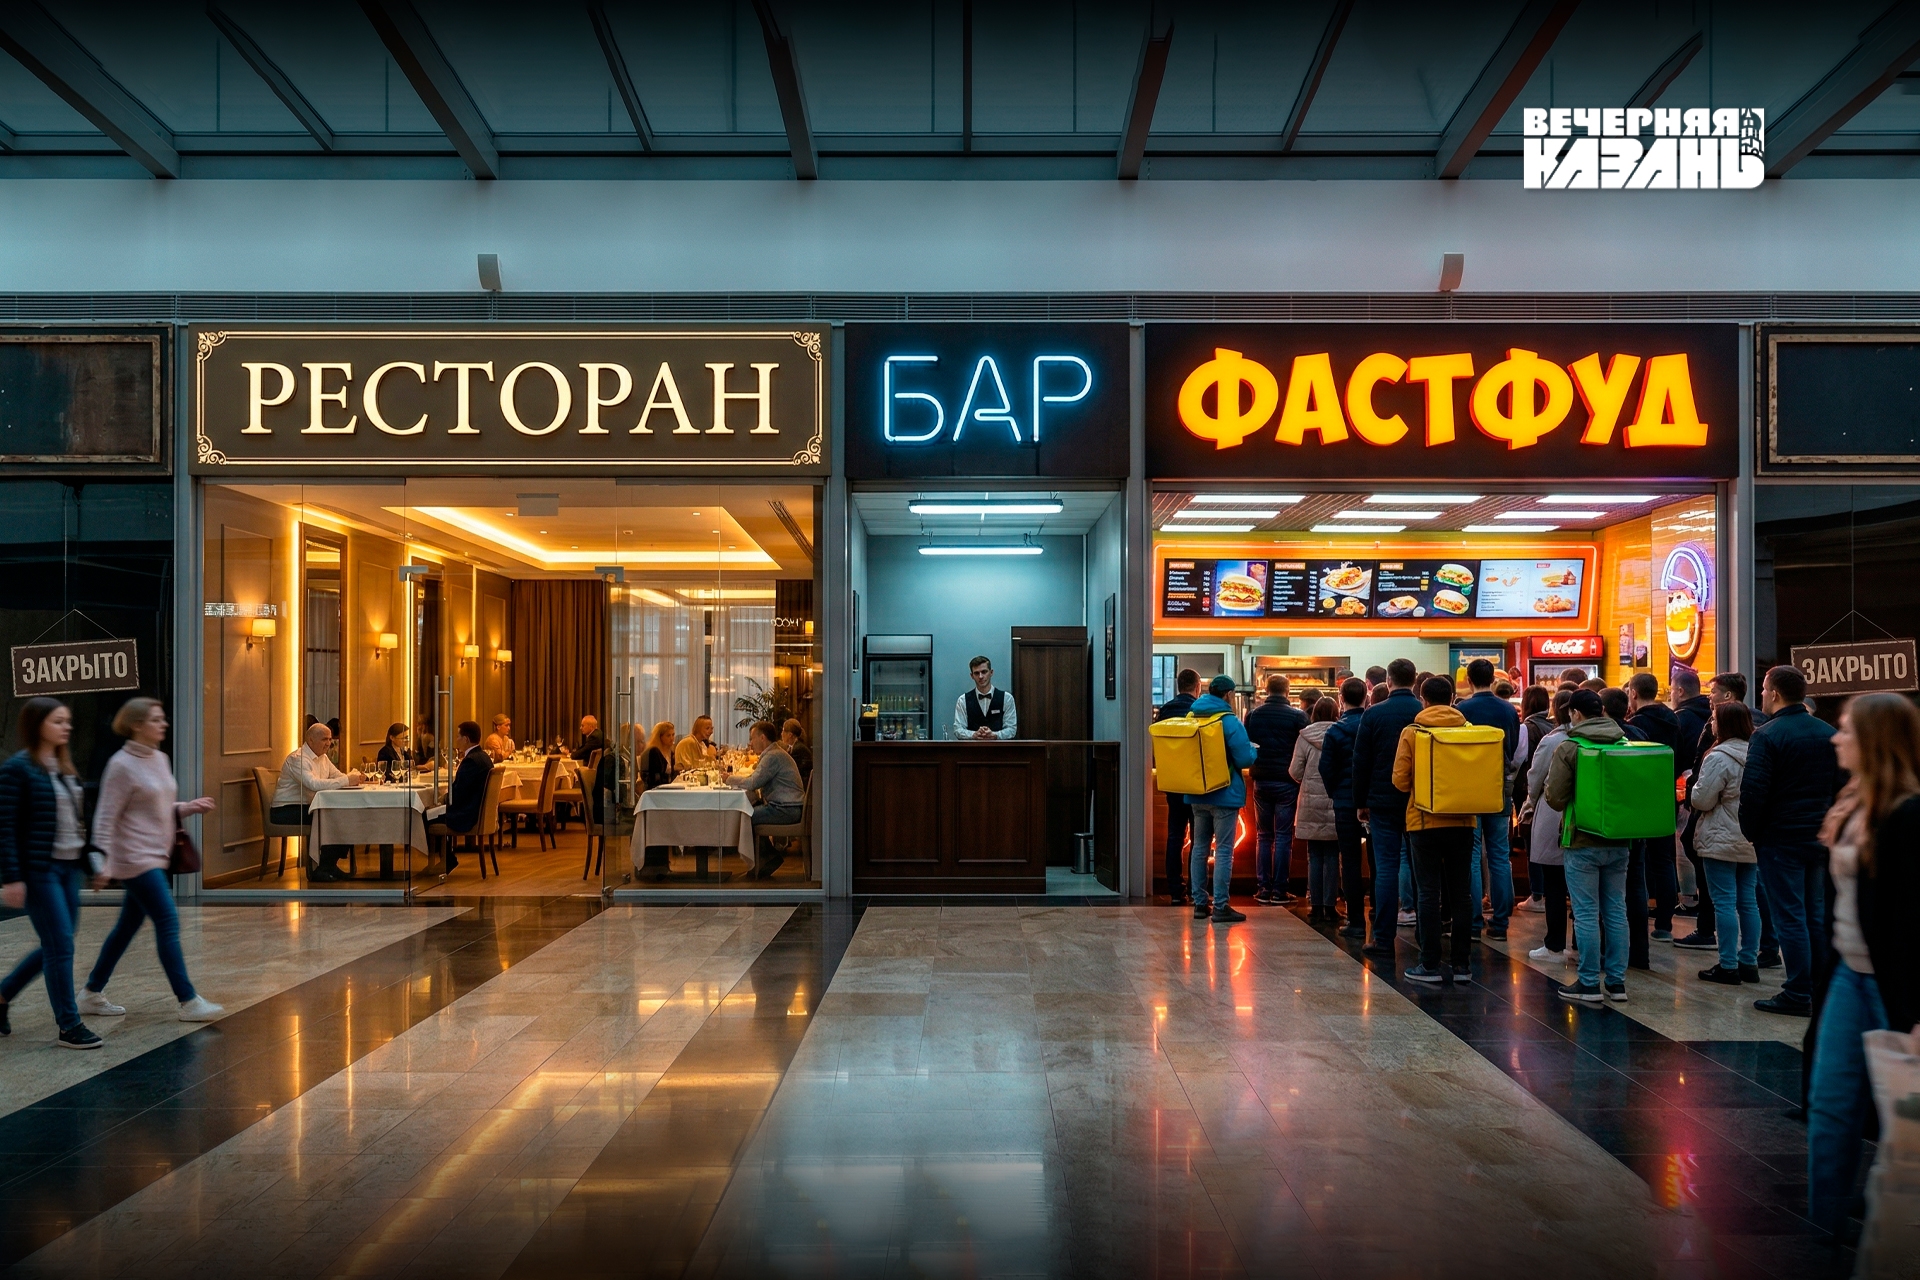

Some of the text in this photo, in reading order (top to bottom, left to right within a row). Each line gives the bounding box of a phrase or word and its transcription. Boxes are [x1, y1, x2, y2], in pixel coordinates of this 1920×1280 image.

[240, 360, 781, 436] РЕСТОРАН
[883, 354, 1093, 443] БАР
[1177, 347, 1709, 451] ФАСТФУД
[21, 651, 128, 684] ЗАКРЫТО
[1801, 652, 1908, 685] ЗАКРЫТО
